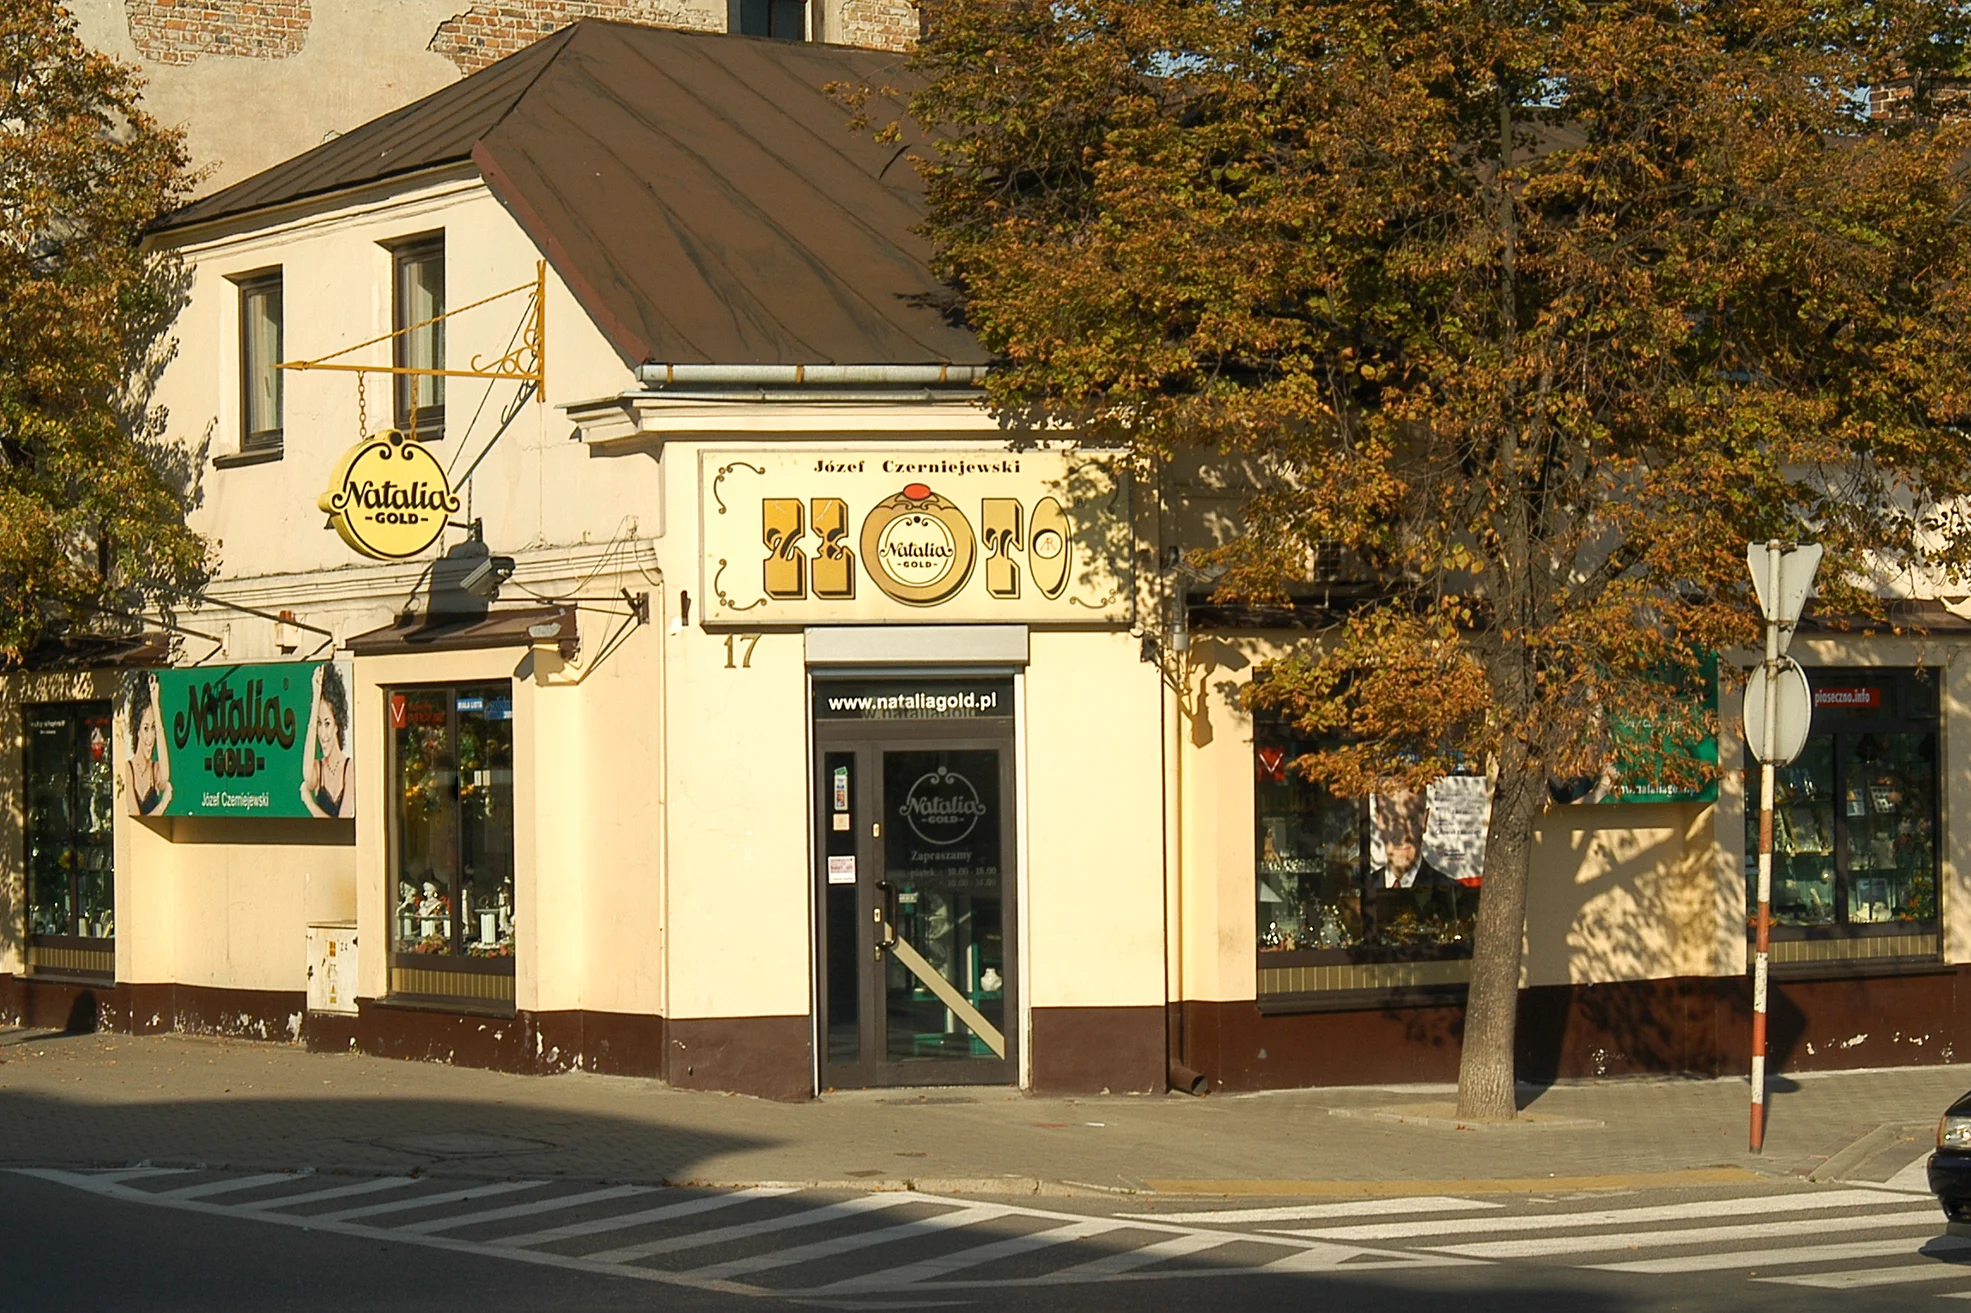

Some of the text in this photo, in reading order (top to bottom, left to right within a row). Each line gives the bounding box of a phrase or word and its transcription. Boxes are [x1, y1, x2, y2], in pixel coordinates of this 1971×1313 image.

[814, 460, 1021, 476] Józef Czerniejewski
[332, 481, 460, 513] Natalia
[880, 541, 953, 558] Natalia
[723, 634, 762, 669] 17
[828, 692, 997, 711] www.nataliagold.pl
[174, 679, 295, 750] Natalia
[899, 796, 986, 816] Natalia
[911, 849, 972, 864] Zapraszamy
